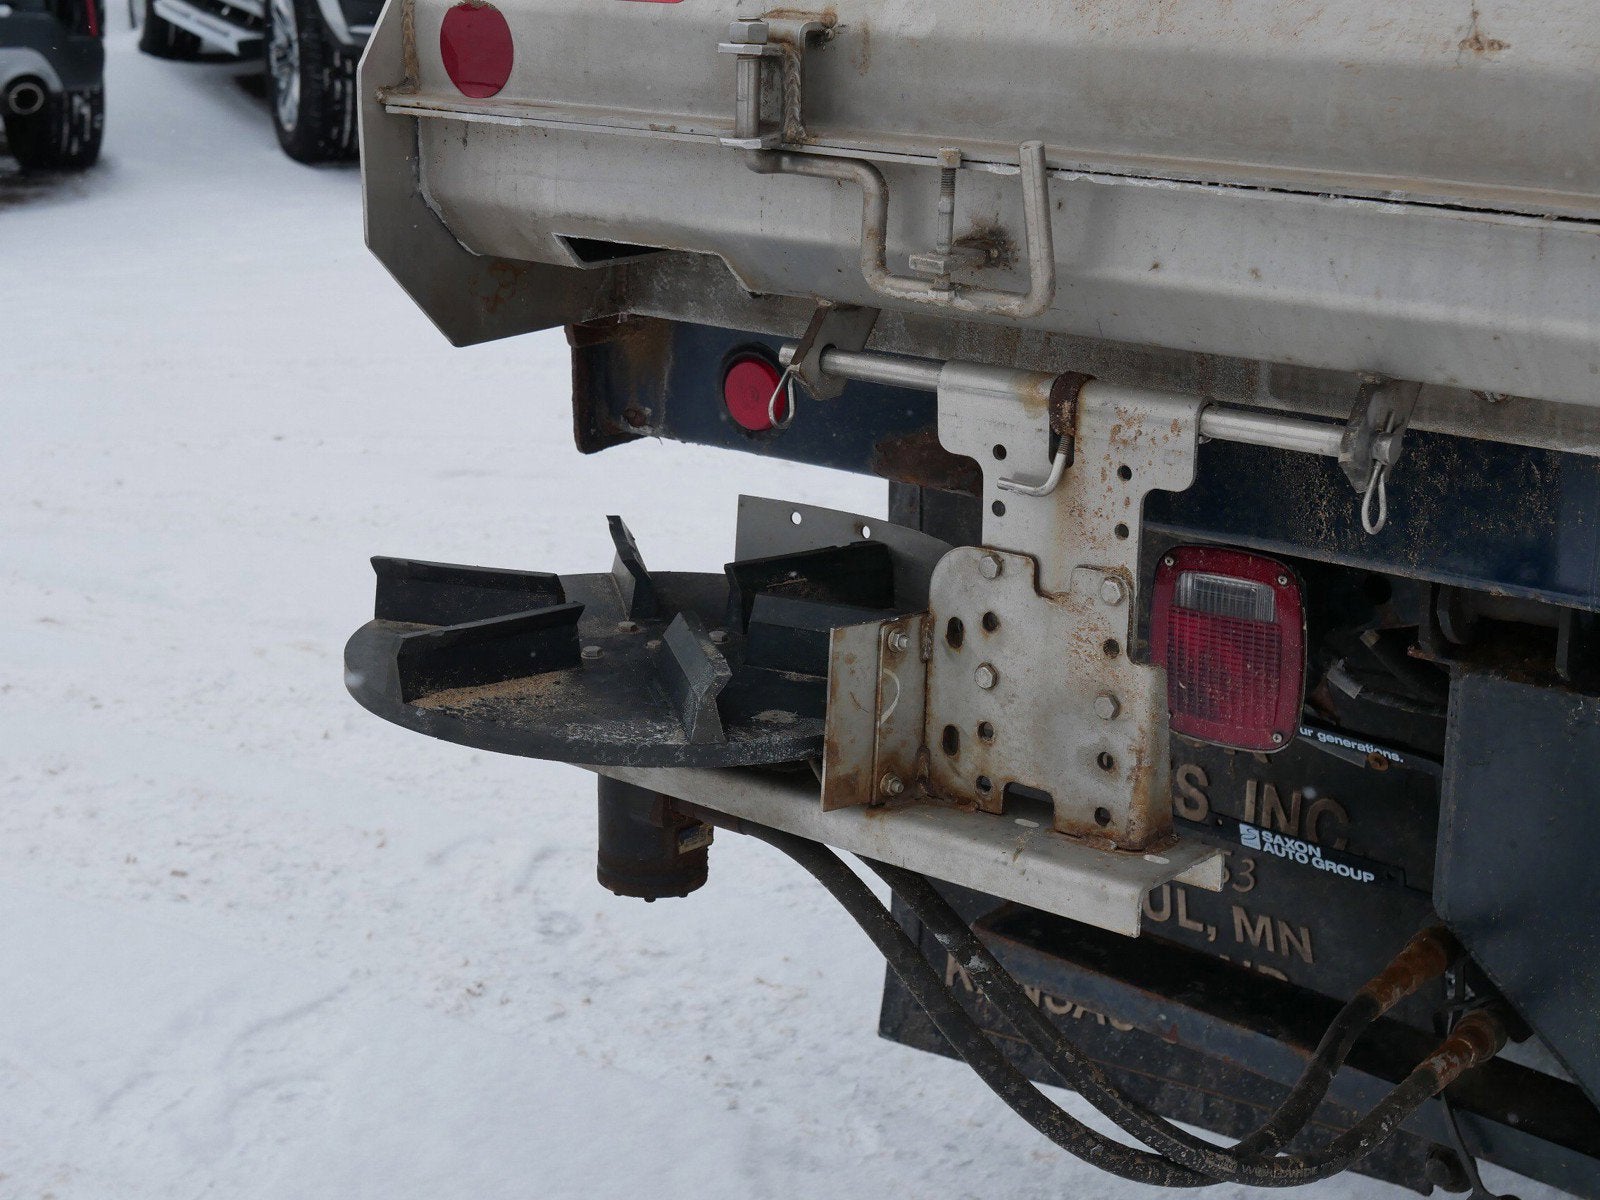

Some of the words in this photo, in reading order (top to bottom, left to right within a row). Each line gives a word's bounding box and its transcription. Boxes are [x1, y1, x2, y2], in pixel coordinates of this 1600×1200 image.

[1299, 726, 1314, 737] ur
[1317, 731, 1404, 763] generations.
[1261, 830, 1322, 858] SAXON
[1263, 842, 1309, 865] AUTO
[1312, 857, 1375, 883] GROUP
[1142, 882, 1217, 942] UL,
[1232, 904, 1314, 964] MN
